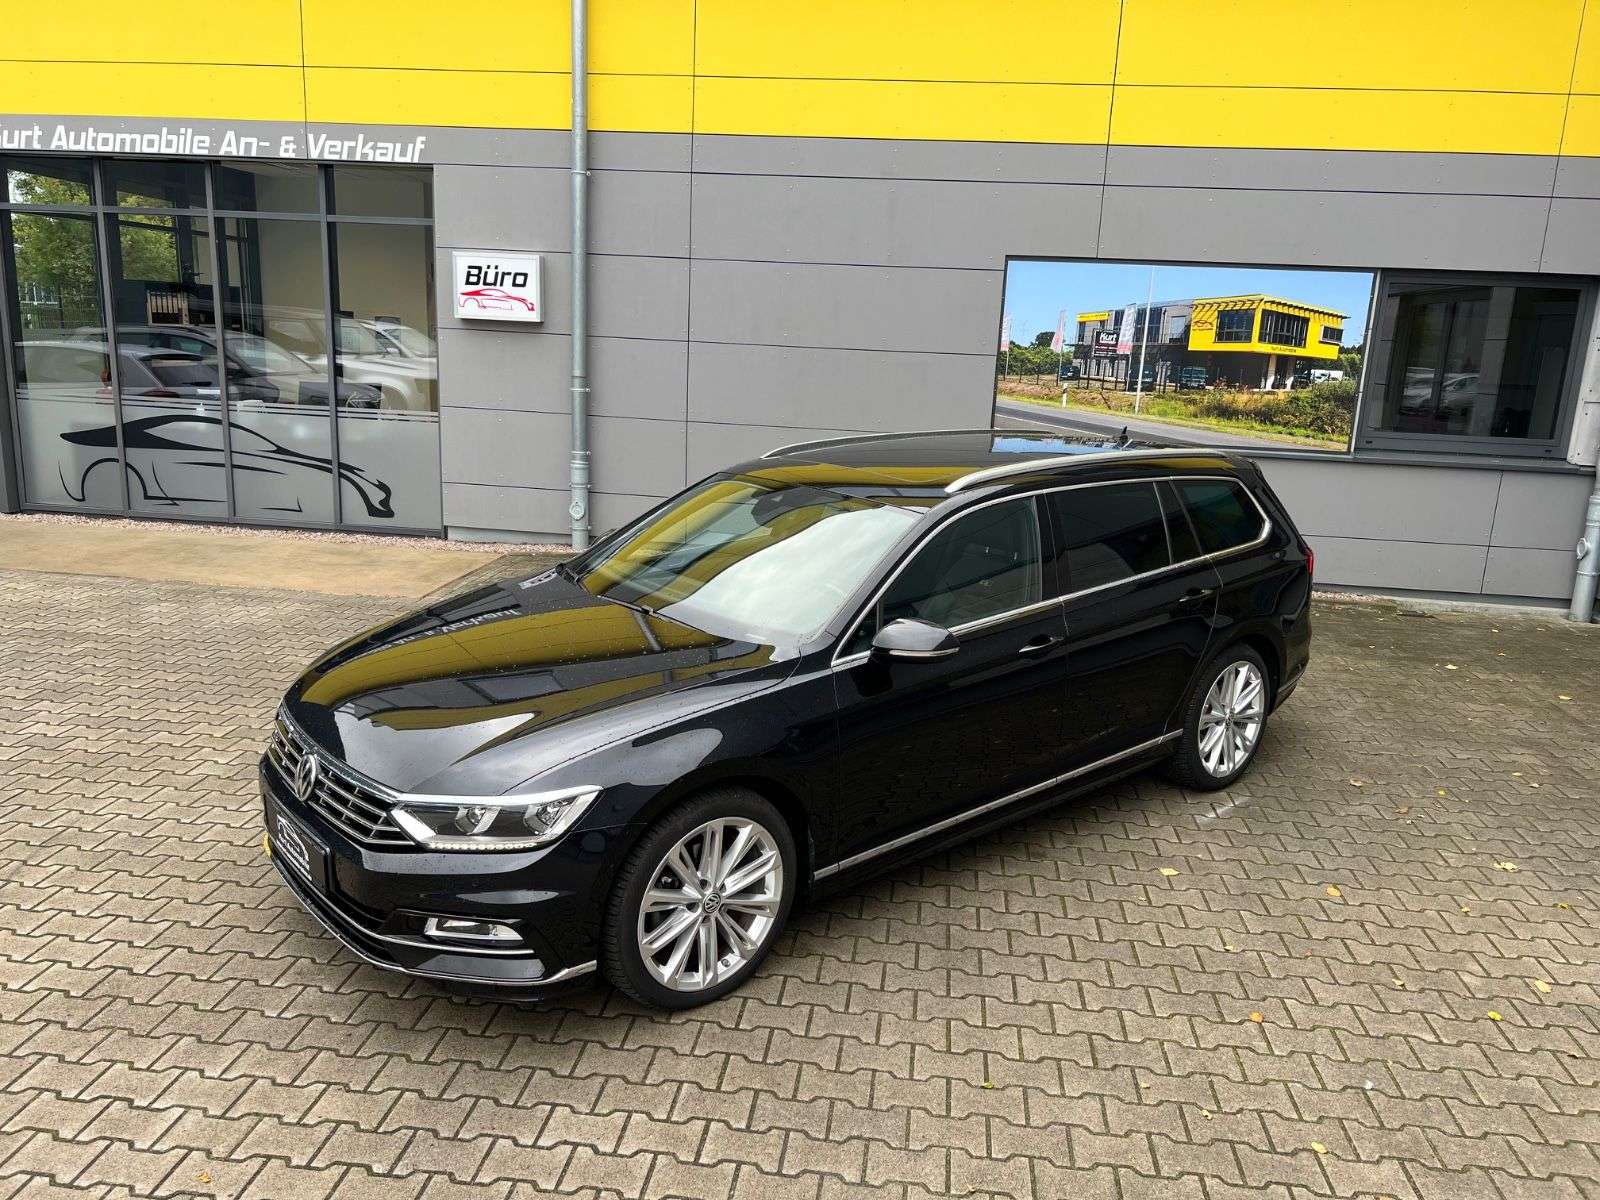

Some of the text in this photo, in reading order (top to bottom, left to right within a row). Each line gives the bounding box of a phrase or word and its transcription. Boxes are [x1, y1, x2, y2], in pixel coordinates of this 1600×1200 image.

[0, 124, 426, 163] urt Automobile An- & Verkauf
[465, 264, 529, 288] Büro
